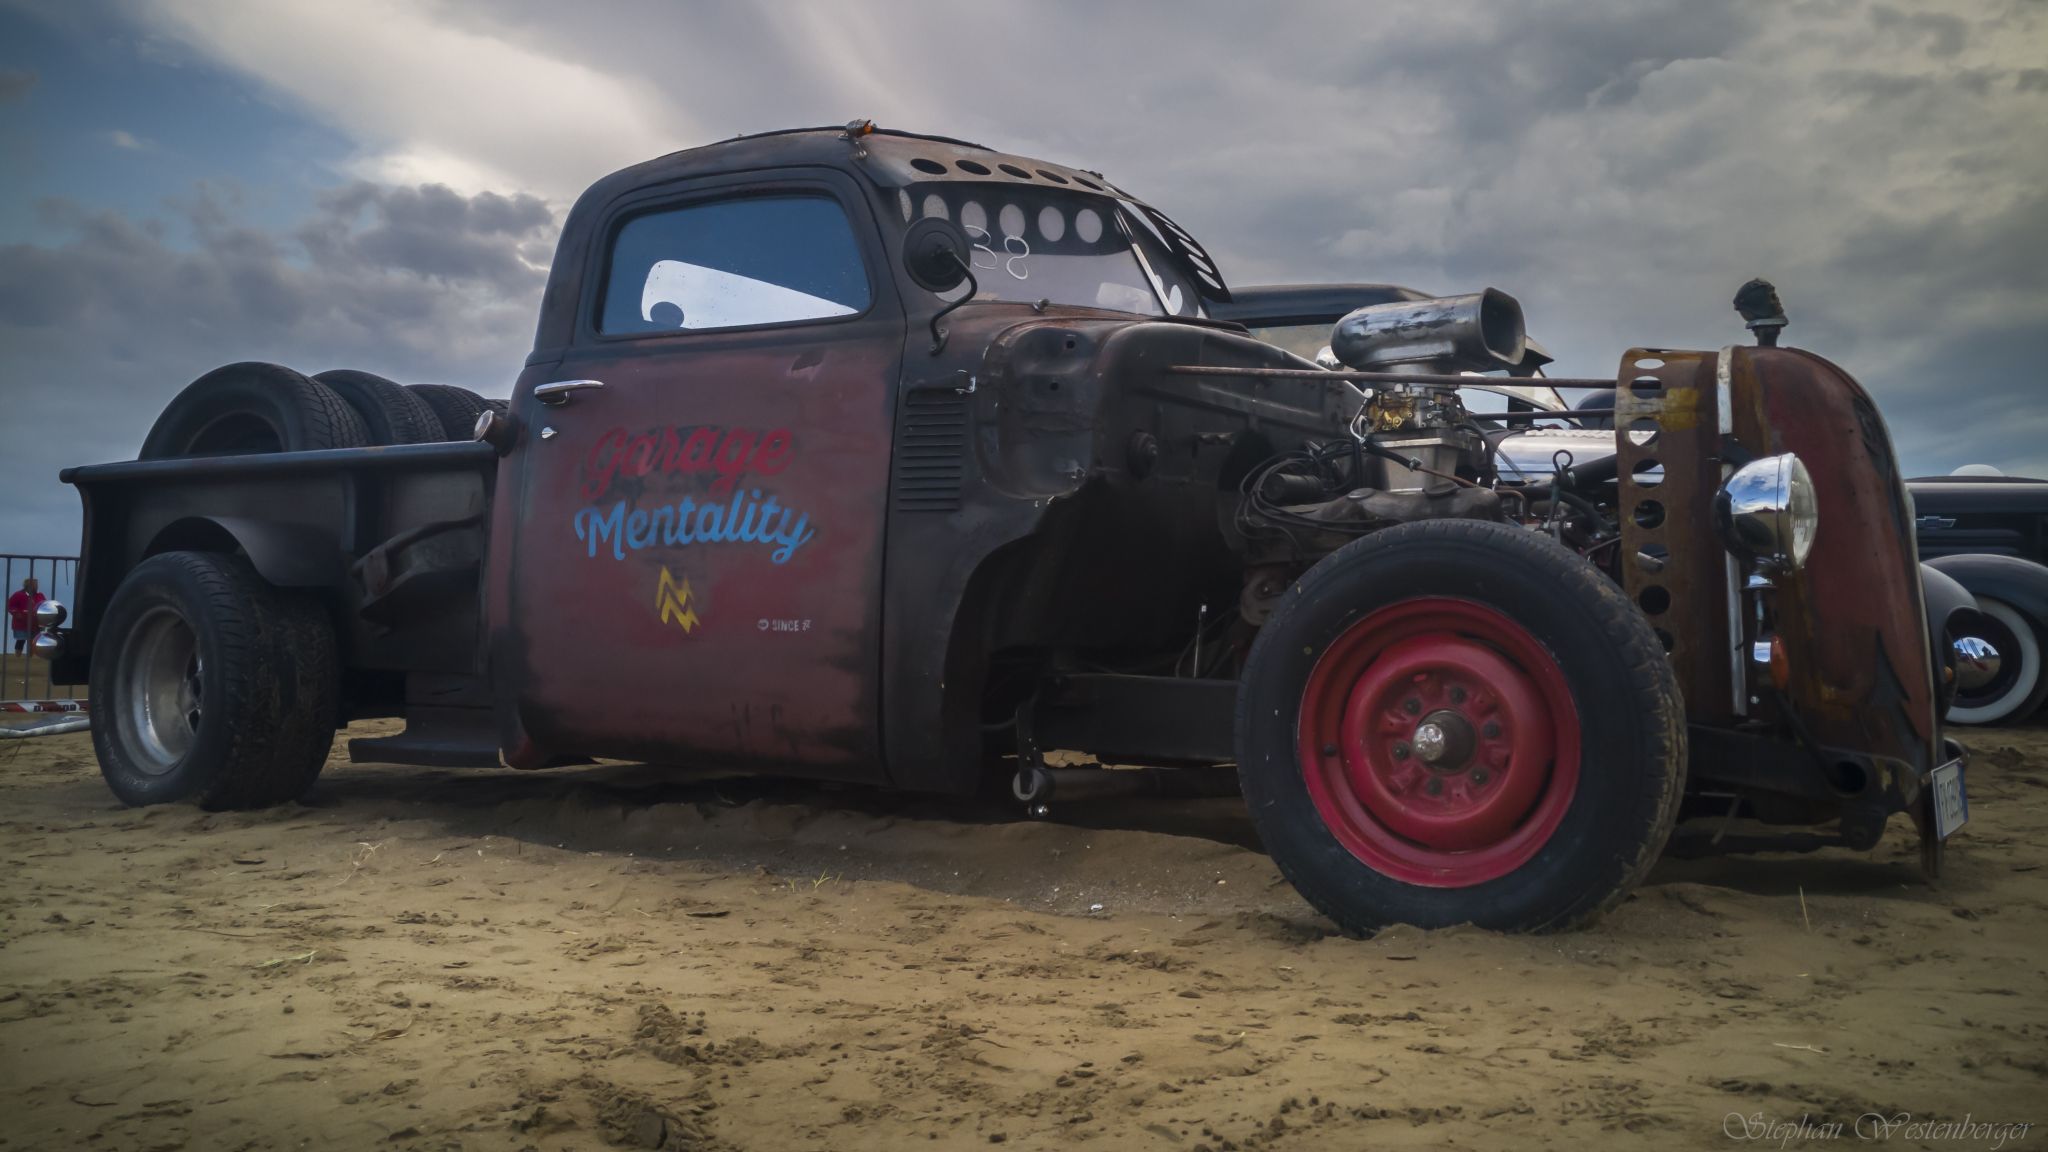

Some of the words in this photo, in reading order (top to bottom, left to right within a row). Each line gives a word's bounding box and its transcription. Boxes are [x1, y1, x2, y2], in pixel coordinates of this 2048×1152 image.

[581, 424, 796, 499] Garage
[574, 488, 818, 565] Mentality
[772, 619, 799, 632] SINCE
